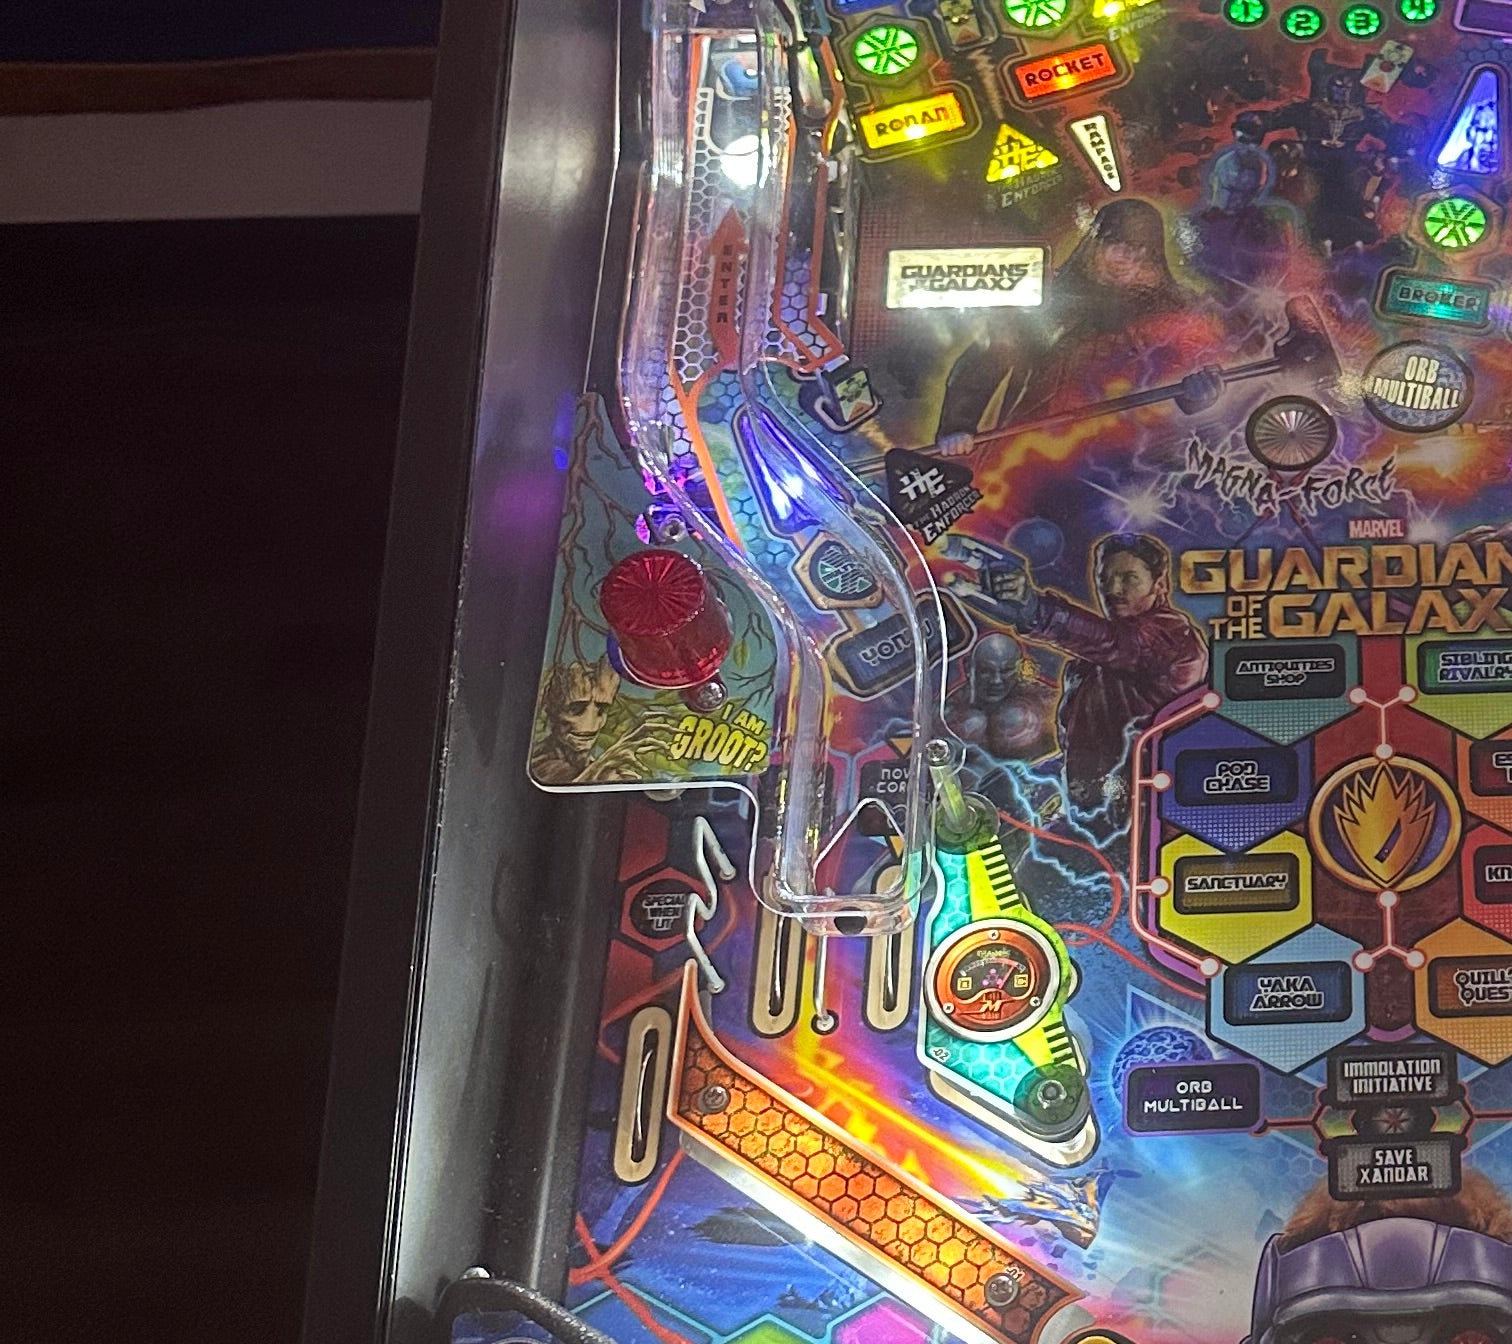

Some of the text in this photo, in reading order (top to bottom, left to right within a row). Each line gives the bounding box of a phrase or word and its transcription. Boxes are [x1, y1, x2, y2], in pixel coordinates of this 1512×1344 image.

[1294, 14, 1312, 32] 2
[1355, 14, 1369, 30] 3
[1024, 50, 1106, 87] ROCKET
[874, 105, 951, 137] RONAN
[901, 263, 1030, 280] GUARDIANS
[1399, 286, 1481, 310] BROKER
[1404, 355, 1439, 383] ORB
[1373, 375, 1461, 409] MULTIBALL
[1349, 518, 1404, 540] MARVEL
[1227, 596, 1265, 616] OF
[1210, 618, 1266, 641] THE
[1263, 670, 1308, 687] SHOP
[723, 702, 767, 735] I AM
[669, 715, 769, 773] GROOT?
[1214, 760, 1258, 778] POD
[1203, 774, 1271, 794] CHASE
[1184, 872, 1289, 891] SANCTUARY
[1256, 974, 1316, 994] YAKA
[1249, 991, 1325, 1011] ARROW
[1343, 1057, 1442, 1078] IMMOLATION
[1175, 1080, 1213, 1095] ORB
[1351, 1074, 1435, 1096] INITIATIVE
[1142, 1096, 1244, 1114] MULTIBALL
[1374, 1148, 1414, 1167] SAVE
[1358, 1165, 1430, 1185] XANDAR
